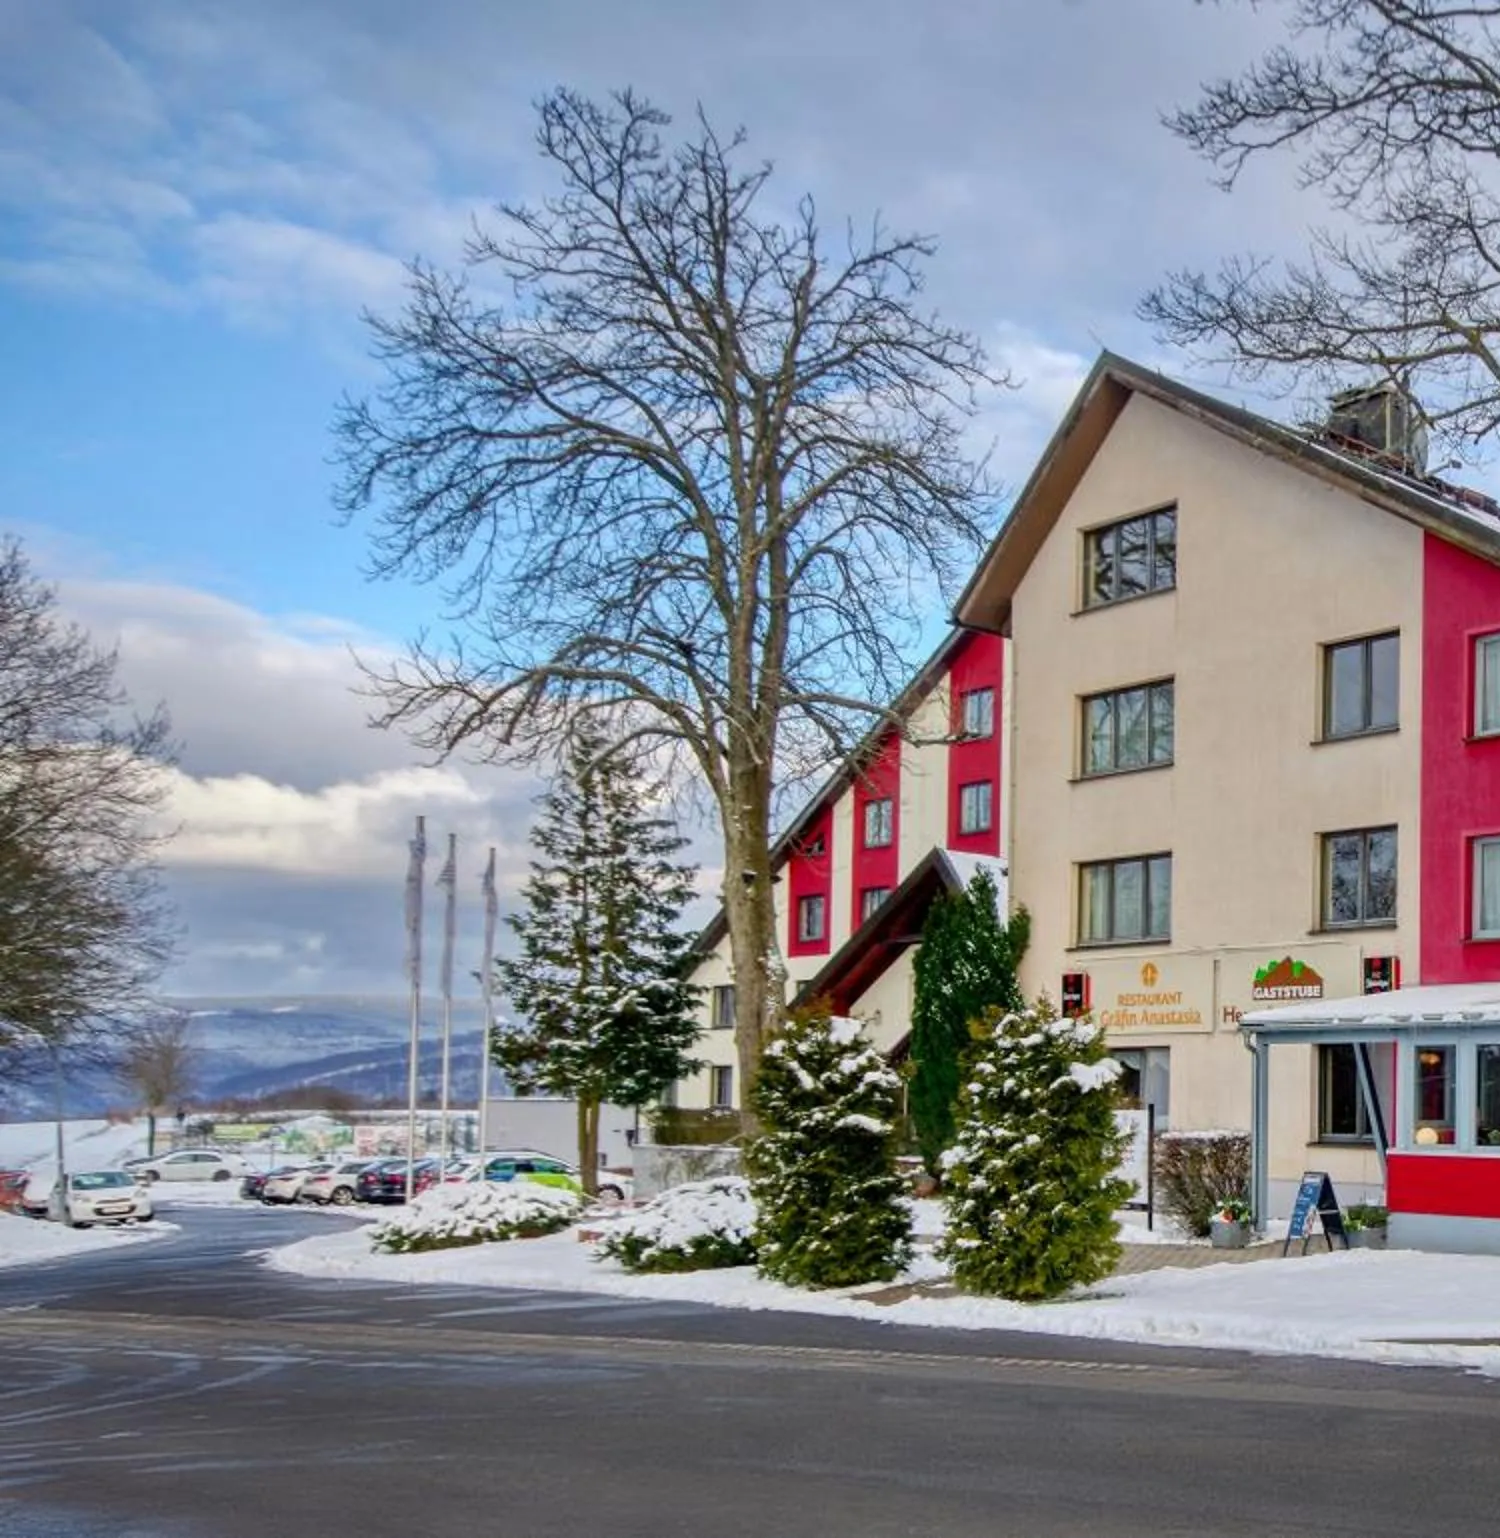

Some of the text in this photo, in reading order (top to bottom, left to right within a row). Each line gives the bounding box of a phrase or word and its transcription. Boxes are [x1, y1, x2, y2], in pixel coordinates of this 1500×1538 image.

[1254, 985, 1321, 998] GASTSTUBE
[1117, 992, 1182, 1006] RESTAURANT
[1101, 1009, 1201, 1029] Gräfin Anastasia
